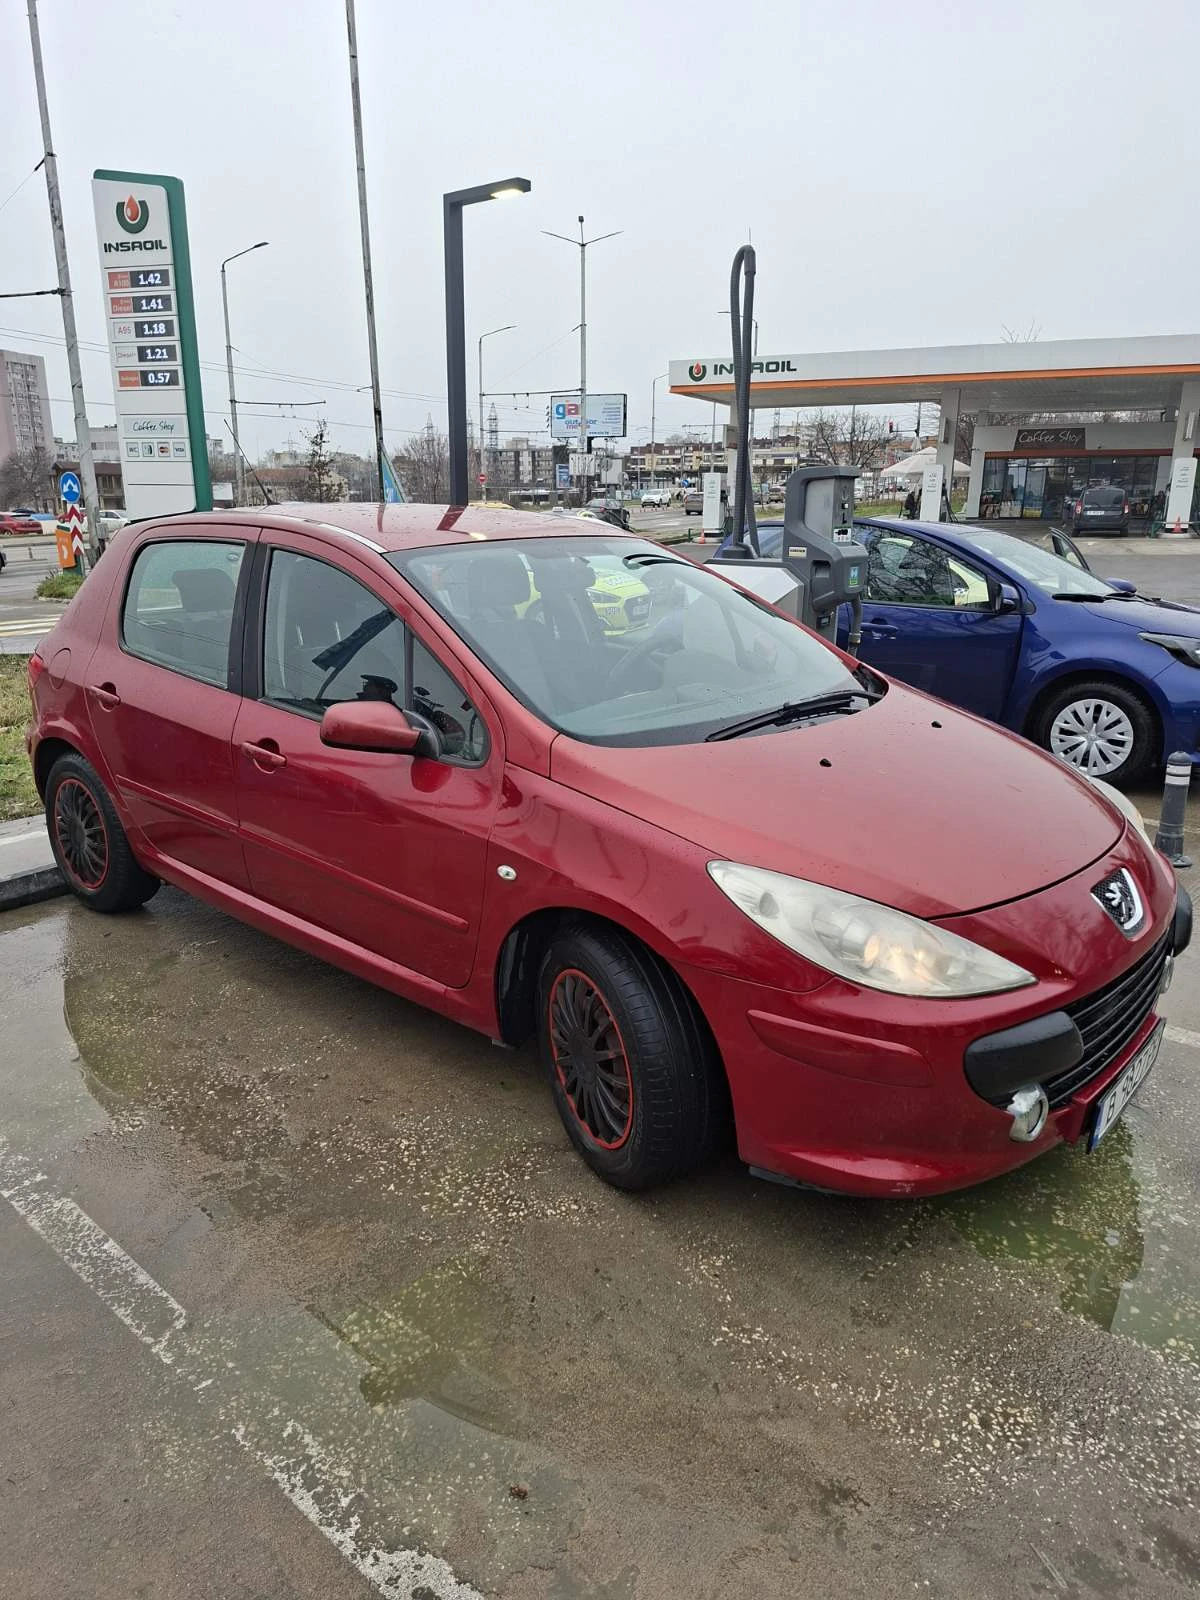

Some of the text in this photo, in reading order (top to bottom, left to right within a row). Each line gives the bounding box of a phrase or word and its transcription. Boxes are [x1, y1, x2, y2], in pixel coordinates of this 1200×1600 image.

[104, 240, 168, 253] INSAOIL
[138, 272, 162, 285] 1.42
[141, 298, 164, 310] 1.41
[143, 323, 166, 335] 1.18
[146, 348, 169, 359] 1.21
[714, 361, 797, 375] INAOIL
[148, 372, 170, 384] 0.57
[133, 420, 175, 434] Coffee Shop
[1019, 430, 1081, 448] Coffee Shop
